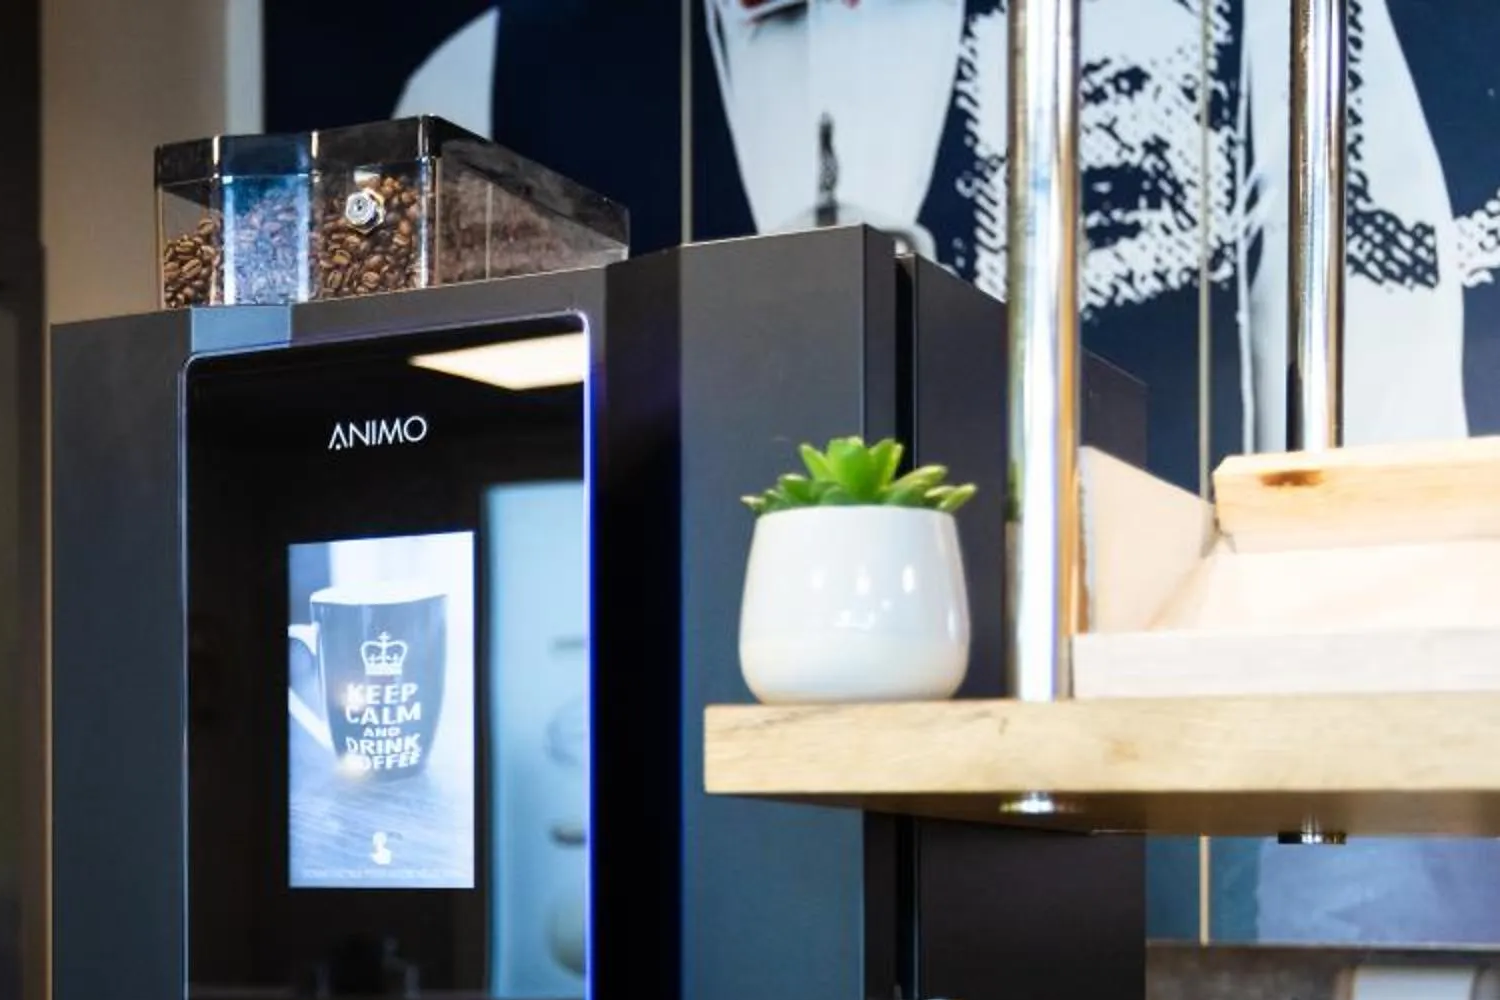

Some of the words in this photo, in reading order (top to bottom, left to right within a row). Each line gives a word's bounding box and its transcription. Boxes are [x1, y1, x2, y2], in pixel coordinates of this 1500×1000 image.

[328, 415, 427, 450] ANIMO
[346, 682, 419, 705] KEEP
[345, 701, 421, 725] CALM
[363, 726, 400, 737] AND
[345, 732, 421, 755] DRINK
[344, 751, 420, 770] OFFEE
